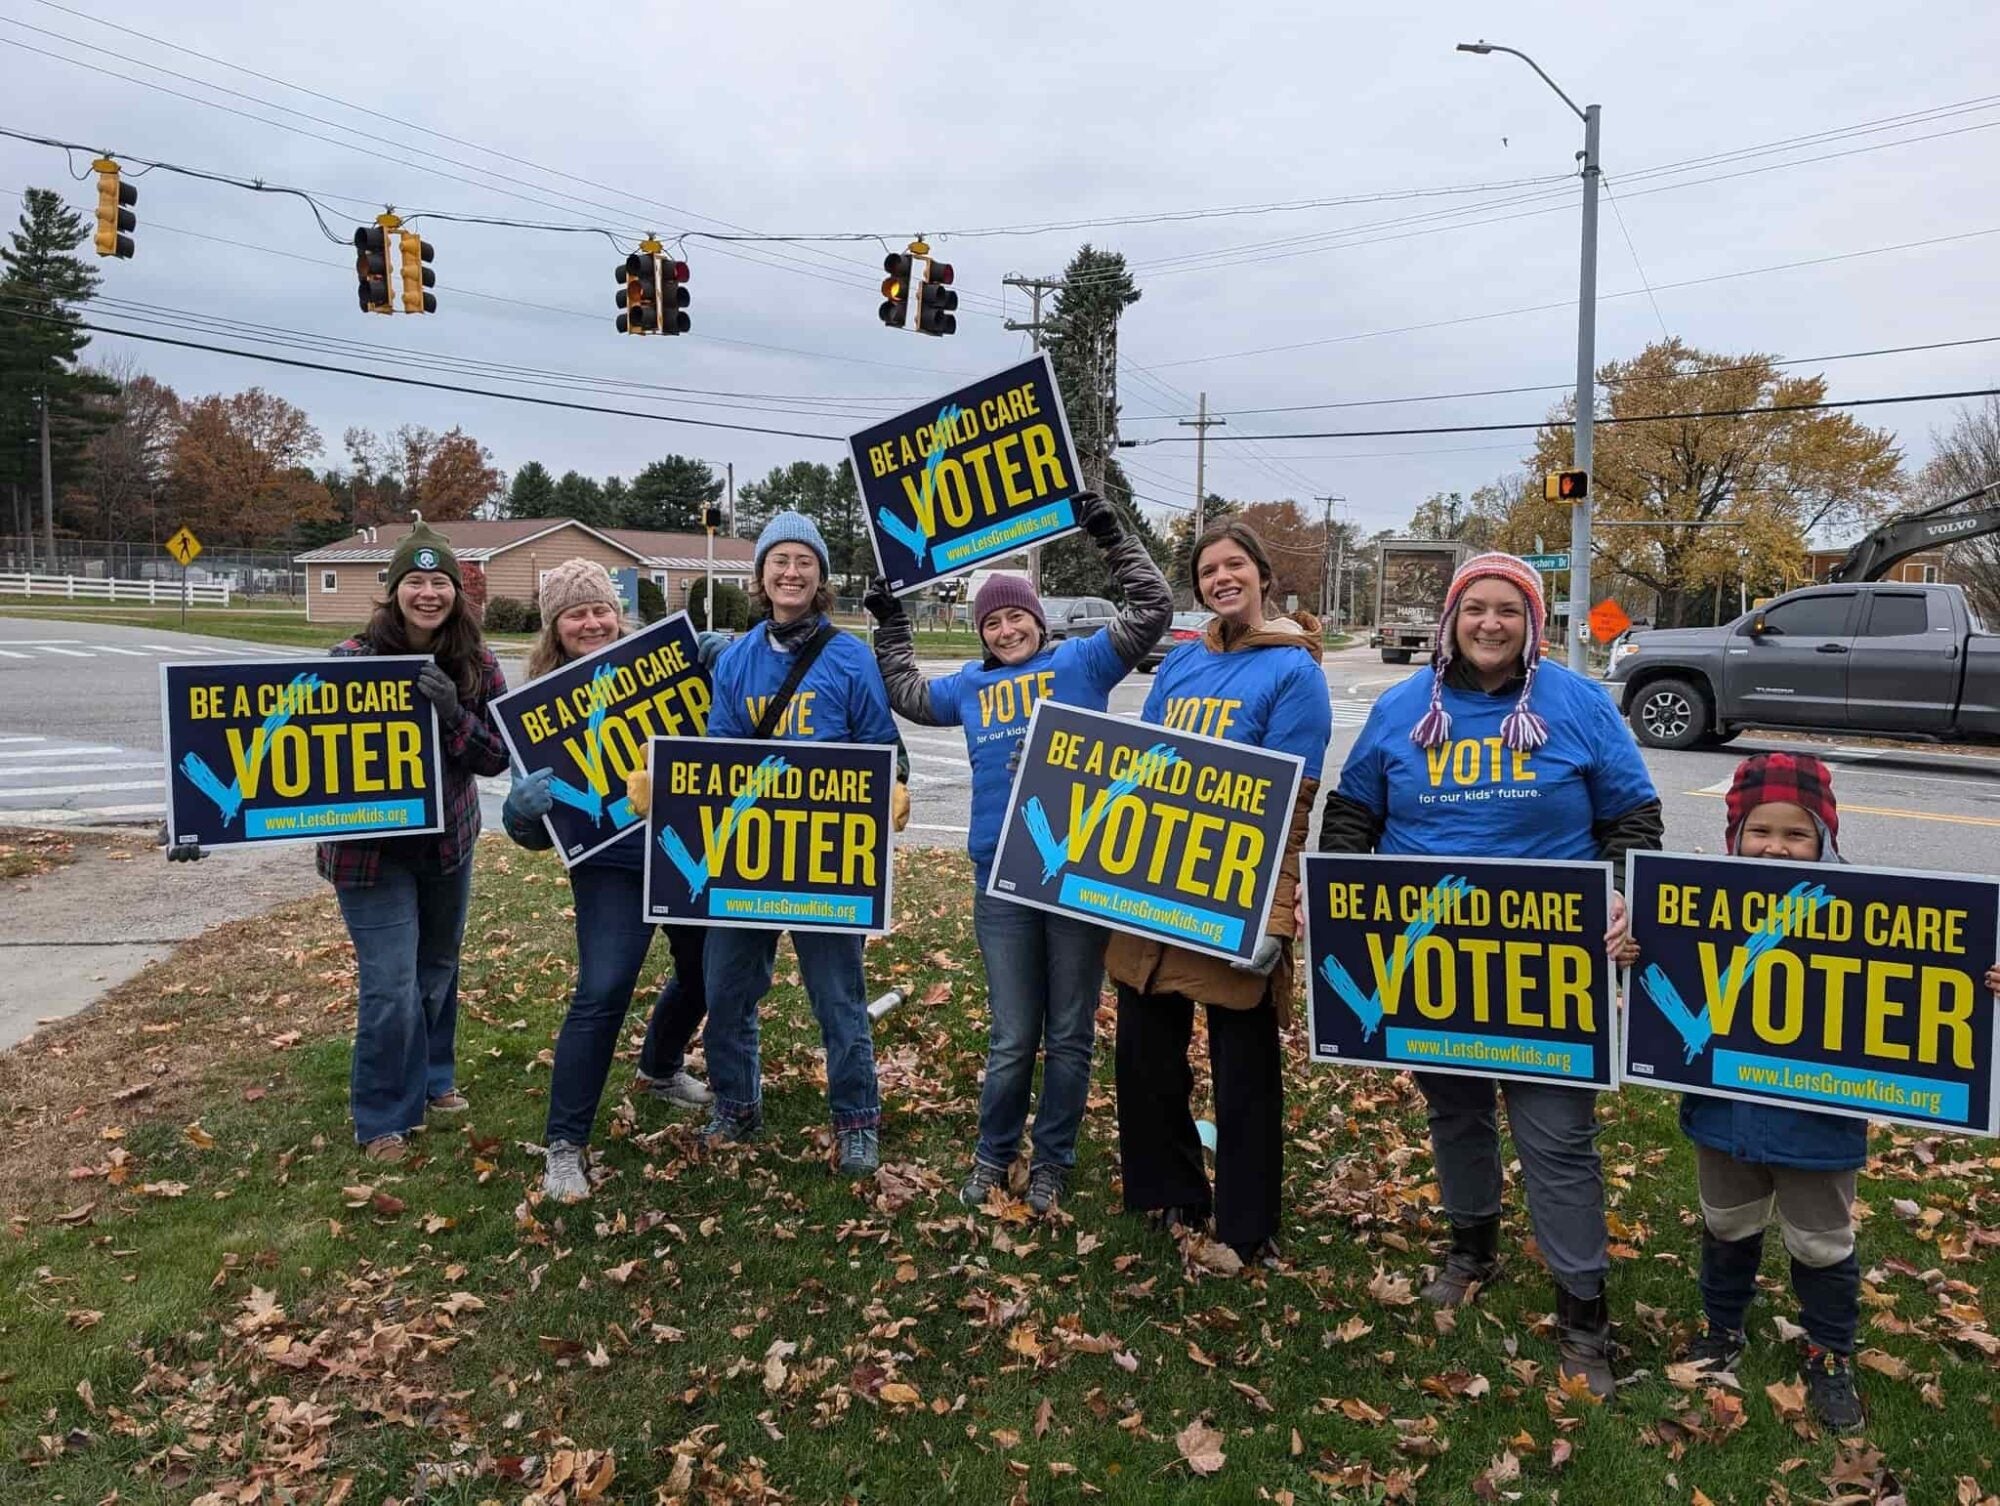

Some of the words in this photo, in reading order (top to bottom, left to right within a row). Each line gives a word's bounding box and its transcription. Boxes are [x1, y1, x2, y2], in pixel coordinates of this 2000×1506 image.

[869, 440, 899, 478] BE
[901, 435, 917, 467] A
[915, 407, 981, 457] CHILD
[980, 382, 1041, 433] CARE
[901, 423, 1069, 538] VOTER
[946, 511, 1059, 561] www.LetsGrowKids.org
[1928, 519, 1977, 535] VOLVO
[190, 685, 225, 719] BE
[233, 684, 251, 718] A
[258, 682, 338, 716] CHILD
[346, 680, 413, 714] CARE
[521, 710, 558, 744] BE
[556, 697, 576, 726] A
[572, 666, 632, 718] CHILD
[632, 640, 691, 687] CARE
[978, 671, 1056, 728] VOTE
[1163, 697, 1242, 739] VOTE
[225, 721, 426, 799] VOTER
[977, 735, 987, 744] for
[989, 732, 1004, 741] our
[1427, 737, 1536, 786] VOTE
[671, 762, 700, 796] BE
[707, 763, 724, 796] A
[730, 763, 802, 800] CHILD
[809, 769, 873, 803] CARE
[1047, 730, 1085, 770] BE
[1084, 741, 1104, 776] A
[1109, 746, 1192, 796] CHILD
[1196, 766, 1272, 816] CARE
[1419, 793, 1436, 804] for
[1440, 793, 1460, 803] our
[1498, 789, 1541, 799] future.
[265, 806, 408, 830] www.LetsGrowKids.org
[699, 805, 877, 887] VOTER
[1066, 782, 1265, 909] VOTER
[726, 898, 857, 920] www.LetsGrowKids.org
[1079, 886, 1224, 943] www.LetsGrowKids.org
[1329, 882, 1366, 920] BE
[1374, 884, 1393, 922] A
[1400, 885, 1491, 928] CHILD
[1500, 890, 1583, 933] CARE
[1658, 883, 1701, 927] BE
[1709, 889, 1732, 931] A
[1742, 891, 1853, 942] CHILD
[1864, 902, 1967, 954] CARE
[1366, 932, 1596, 1033] VOTER
[1698, 941, 1975, 1070] VOTER
[1406, 1037, 1571, 1073] www.LetsGrowKids.org
[1738, 1062, 1941, 1115] www.LetsGrowKids.org
